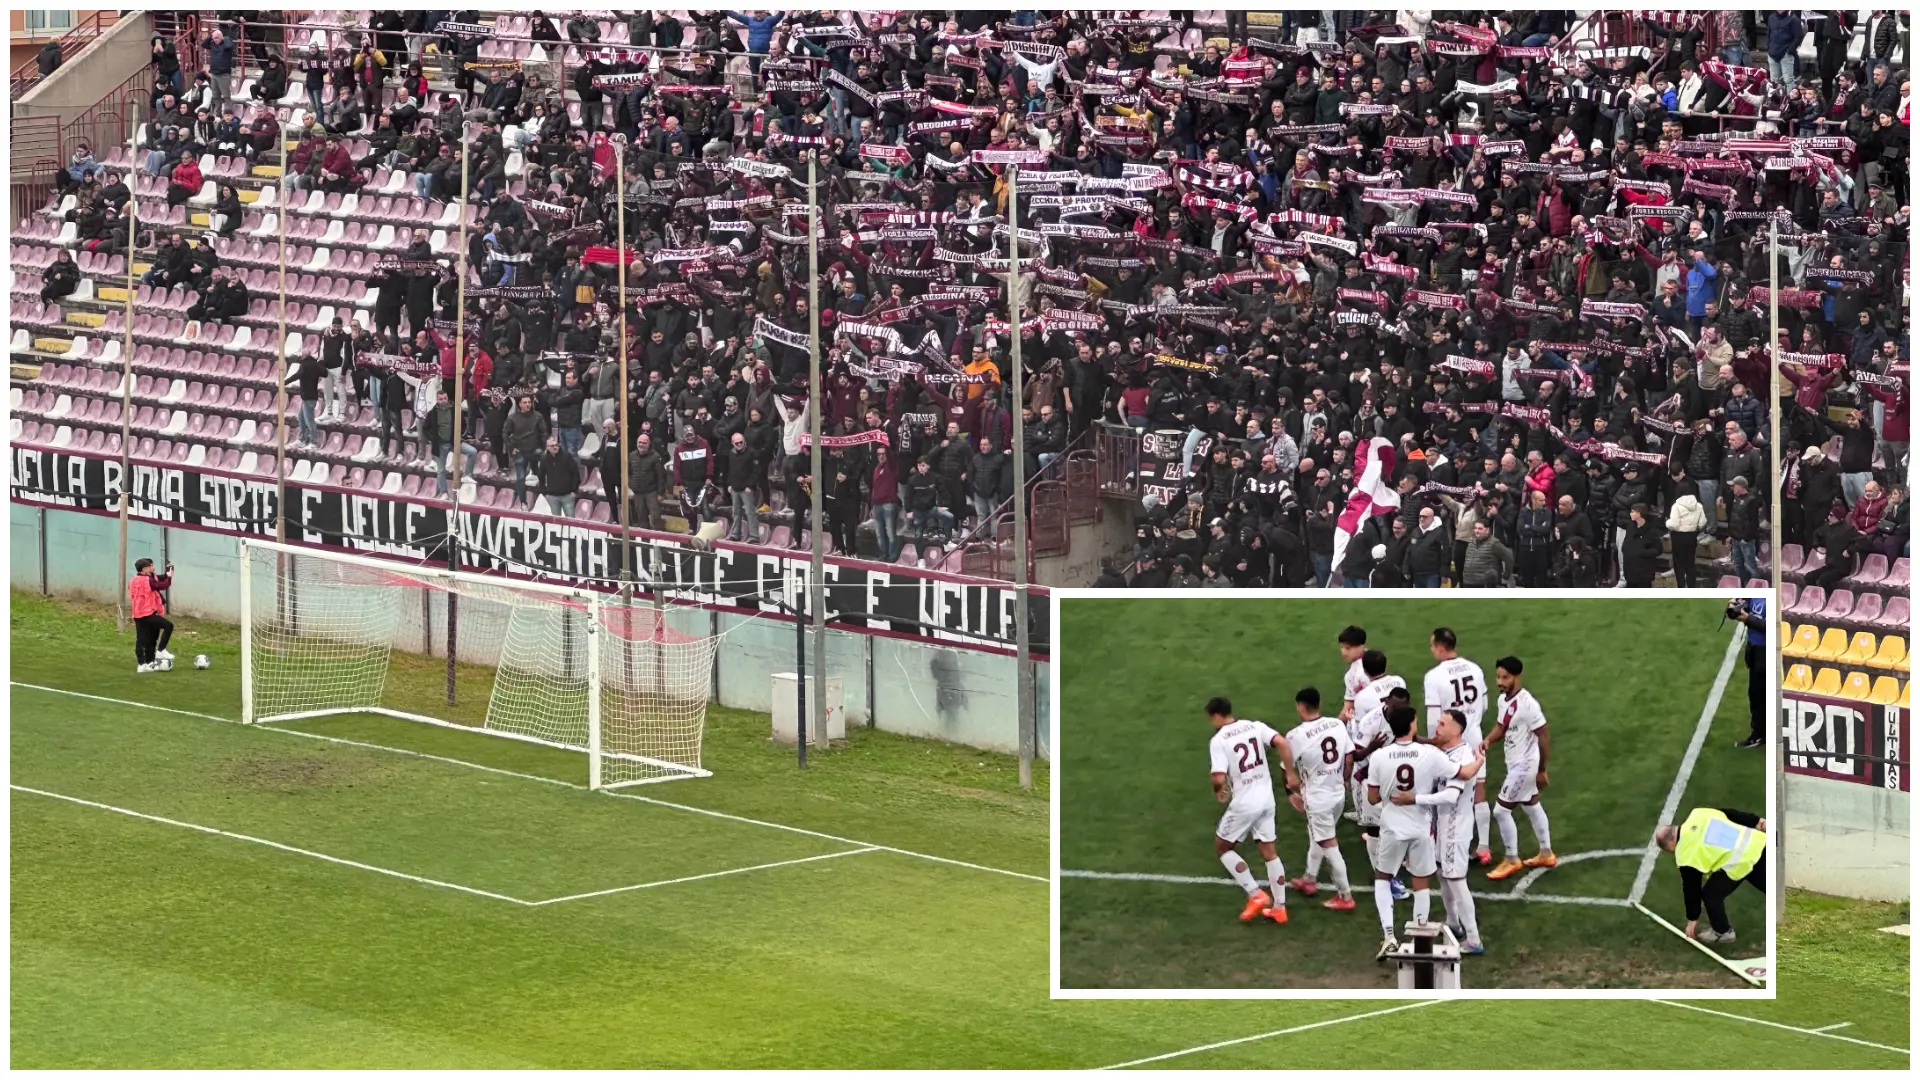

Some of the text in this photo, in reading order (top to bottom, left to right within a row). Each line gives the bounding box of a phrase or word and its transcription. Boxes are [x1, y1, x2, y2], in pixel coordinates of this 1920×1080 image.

[200, 473, 279, 537] SORTE
[302, 488, 323, 544] E
[342, 493, 426, 560] NELLE
[866, 569, 892, 630] E
[1450, 675, 1478, 707] 15
[1233, 737, 1263, 773] 21
[1321, 736, 1339, 765] 8
[1396, 764, 1415, 791] 9
